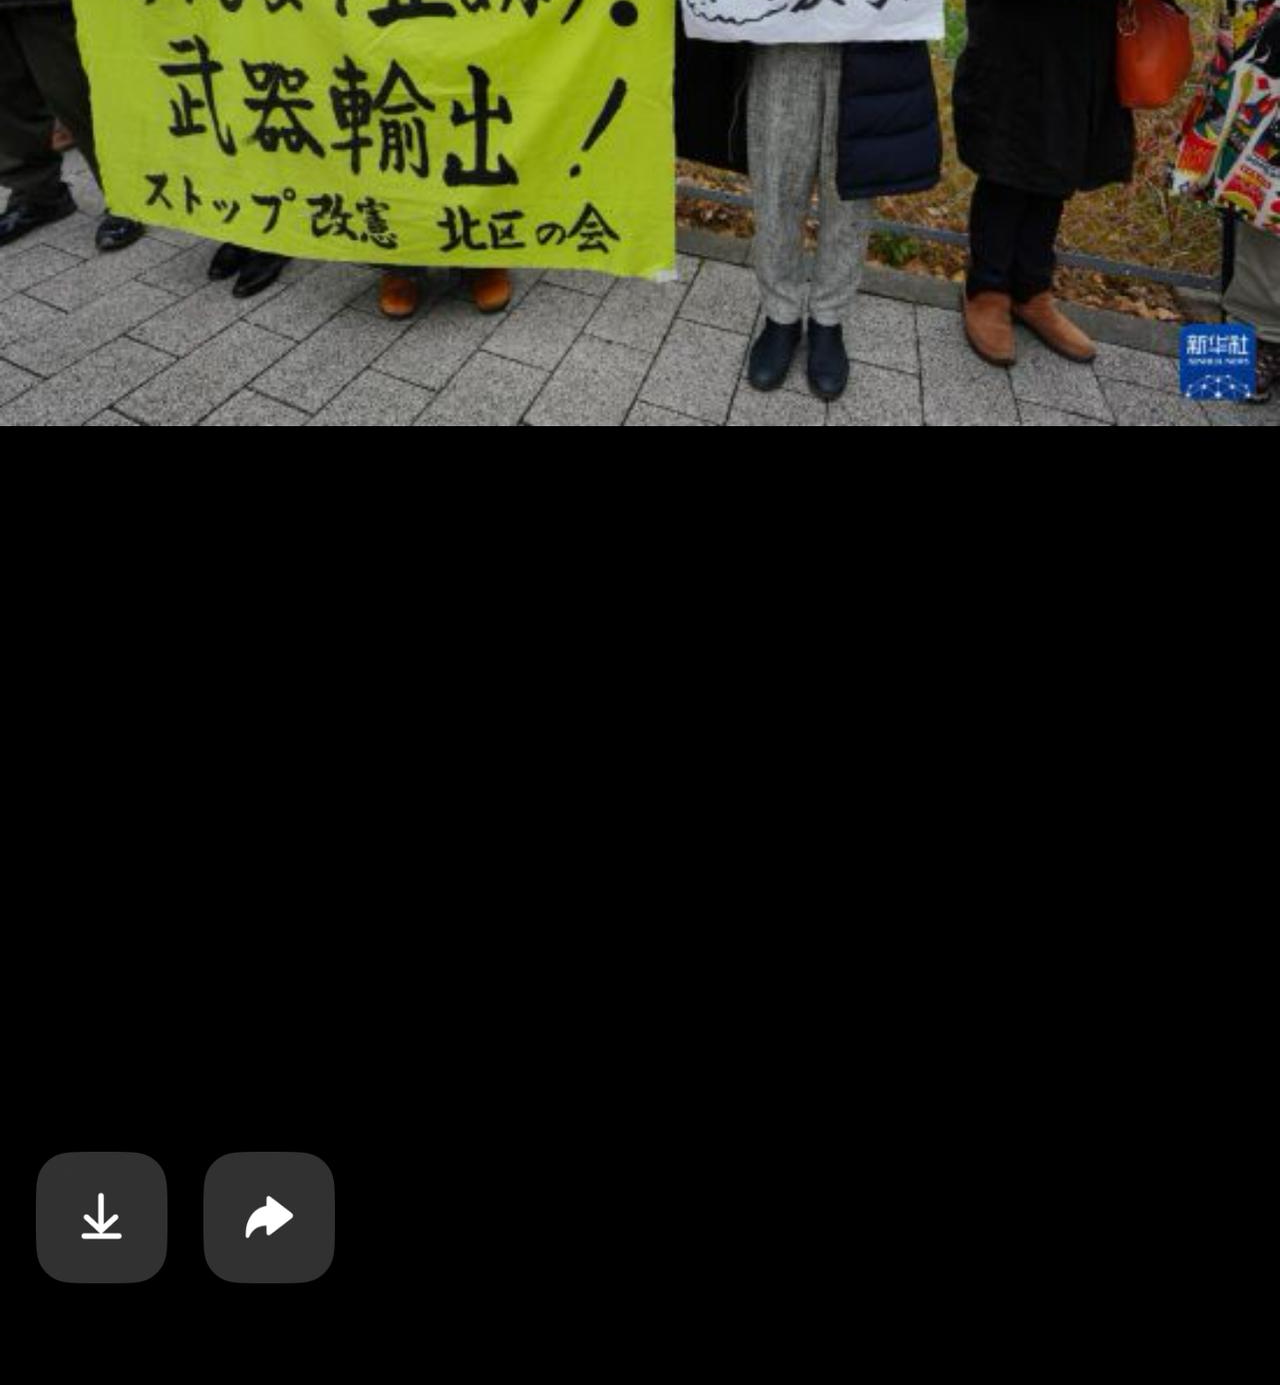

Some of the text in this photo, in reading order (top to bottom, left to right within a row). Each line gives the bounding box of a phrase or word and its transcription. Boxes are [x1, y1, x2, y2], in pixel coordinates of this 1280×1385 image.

[145, 172, 620, 254] ストップ改憲 北区の会
